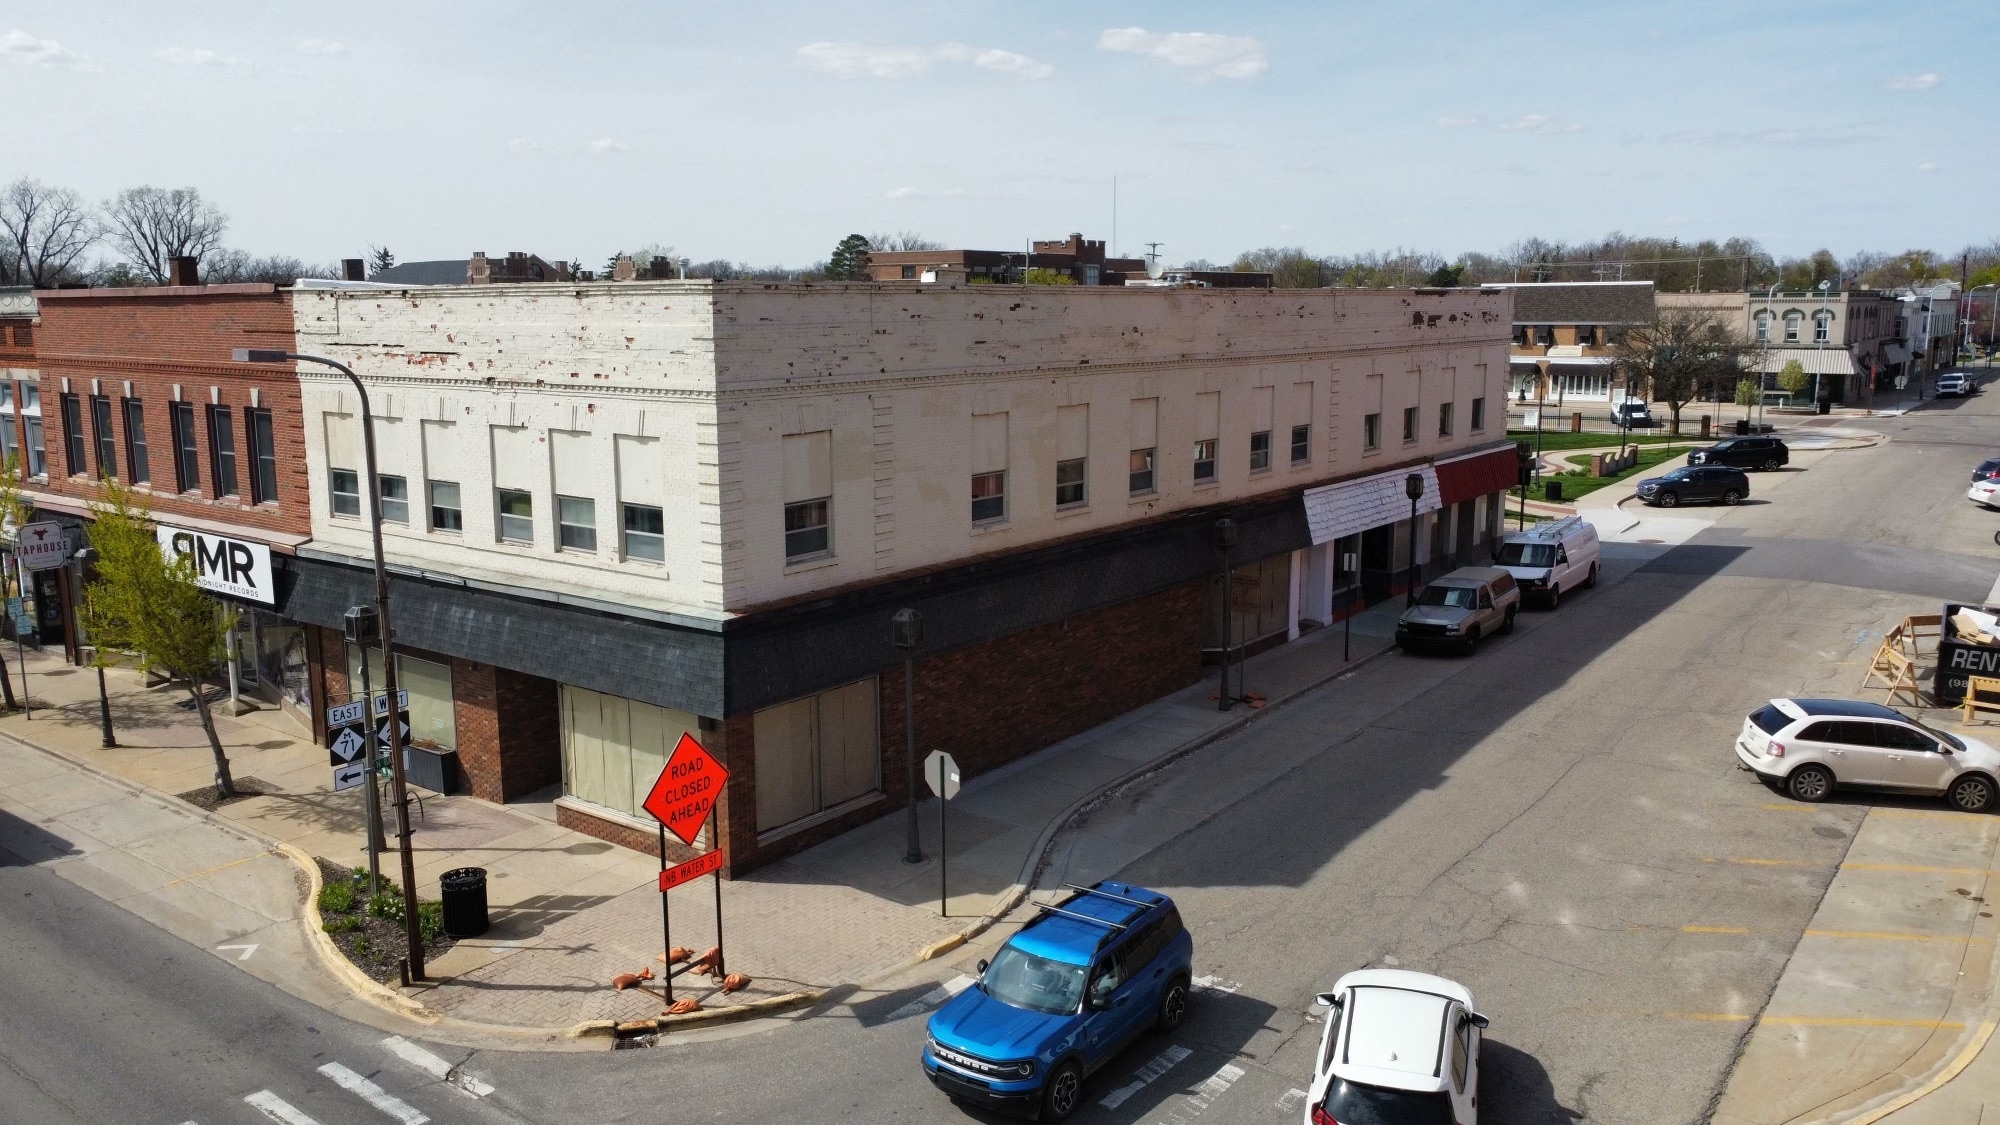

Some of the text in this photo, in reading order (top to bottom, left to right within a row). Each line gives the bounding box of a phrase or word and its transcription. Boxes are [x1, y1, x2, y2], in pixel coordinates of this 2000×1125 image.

[16, 541, 68, 557] TAPHOUSE
[229, 585, 259, 598] RECORDS
[1951, 648, 2000, 673] REN
[380, 694, 405, 710] WT
[333, 706, 358, 722] EAST
[343, 731, 352, 740] M
[340, 739, 355, 754] 71
[671, 757, 703, 780] ROAD
[665, 776, 711, 805] CLOSED
[670, 797, 709, 824] AHEAD
[664, 854, 718, 886] NB WATER ST
